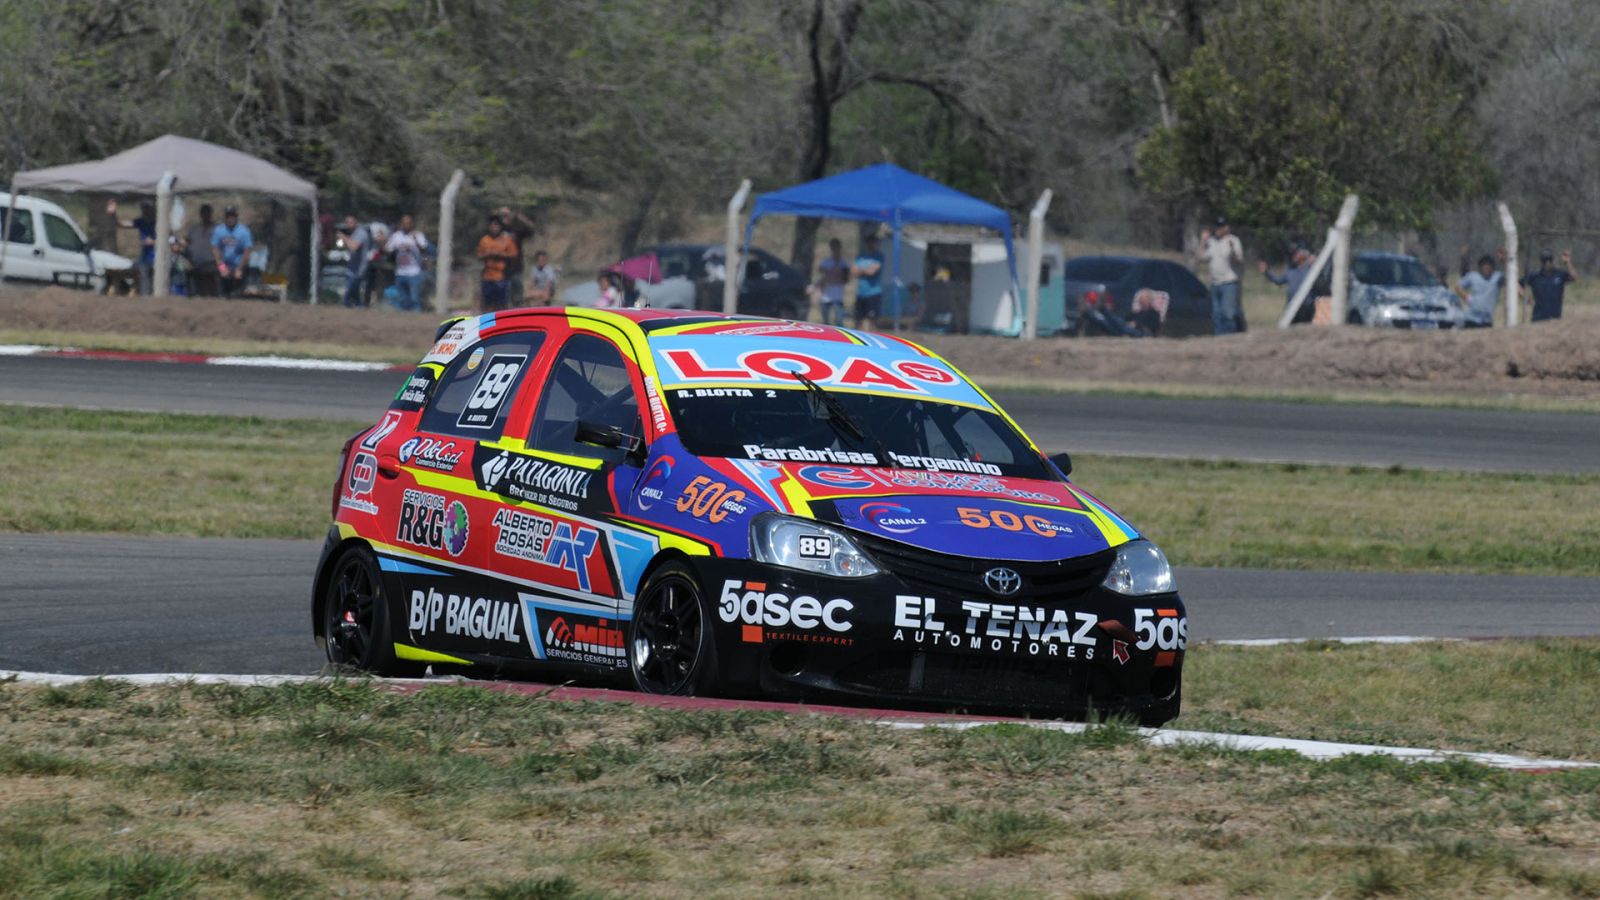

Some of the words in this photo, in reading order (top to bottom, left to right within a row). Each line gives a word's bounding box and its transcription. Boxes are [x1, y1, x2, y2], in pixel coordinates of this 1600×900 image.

[468, 363, 519, 409] 89
[677, 390, 693, 398] R.
[695, 389, 753, 397] BLOTTA
[765, 390, 777, 398] 2
[743, 444, 878, 465] Parabrisas
[888, 451, 1002, 476] ergamino
[504, 457, 592, 498] PATAGONIA
[403, 489, 445, 509] SERVICIOS
[539, 494, 547, 503] DE
[721, 500, 747, 514] MEGAS
[398, 502, 445, 548] R&G
[494, 510, 553, 537] ALBERTO
[1036, 522, 1073, 533] MEGAS
[496, 544, 520, 556] SOCIEDAD
[499, 529, 545, 552] ROSAS
[800, 537, 831, 556] 89
[409, 587, 443, 636] B/P
[446, 594, 520, 643] BAGUAL
[719, 579, 854, 632] 5asec
[895, 595, 944, 631] EL
[962, 600, 1098, 646] TENAZ
[766, 632, 809, 641] TEXTILE
[812, 634, 854, 646] EXPERT
[893, 629, 1095, 660] AUTOMOTORES
[546, 648, 582, 661] SERVICIOS
